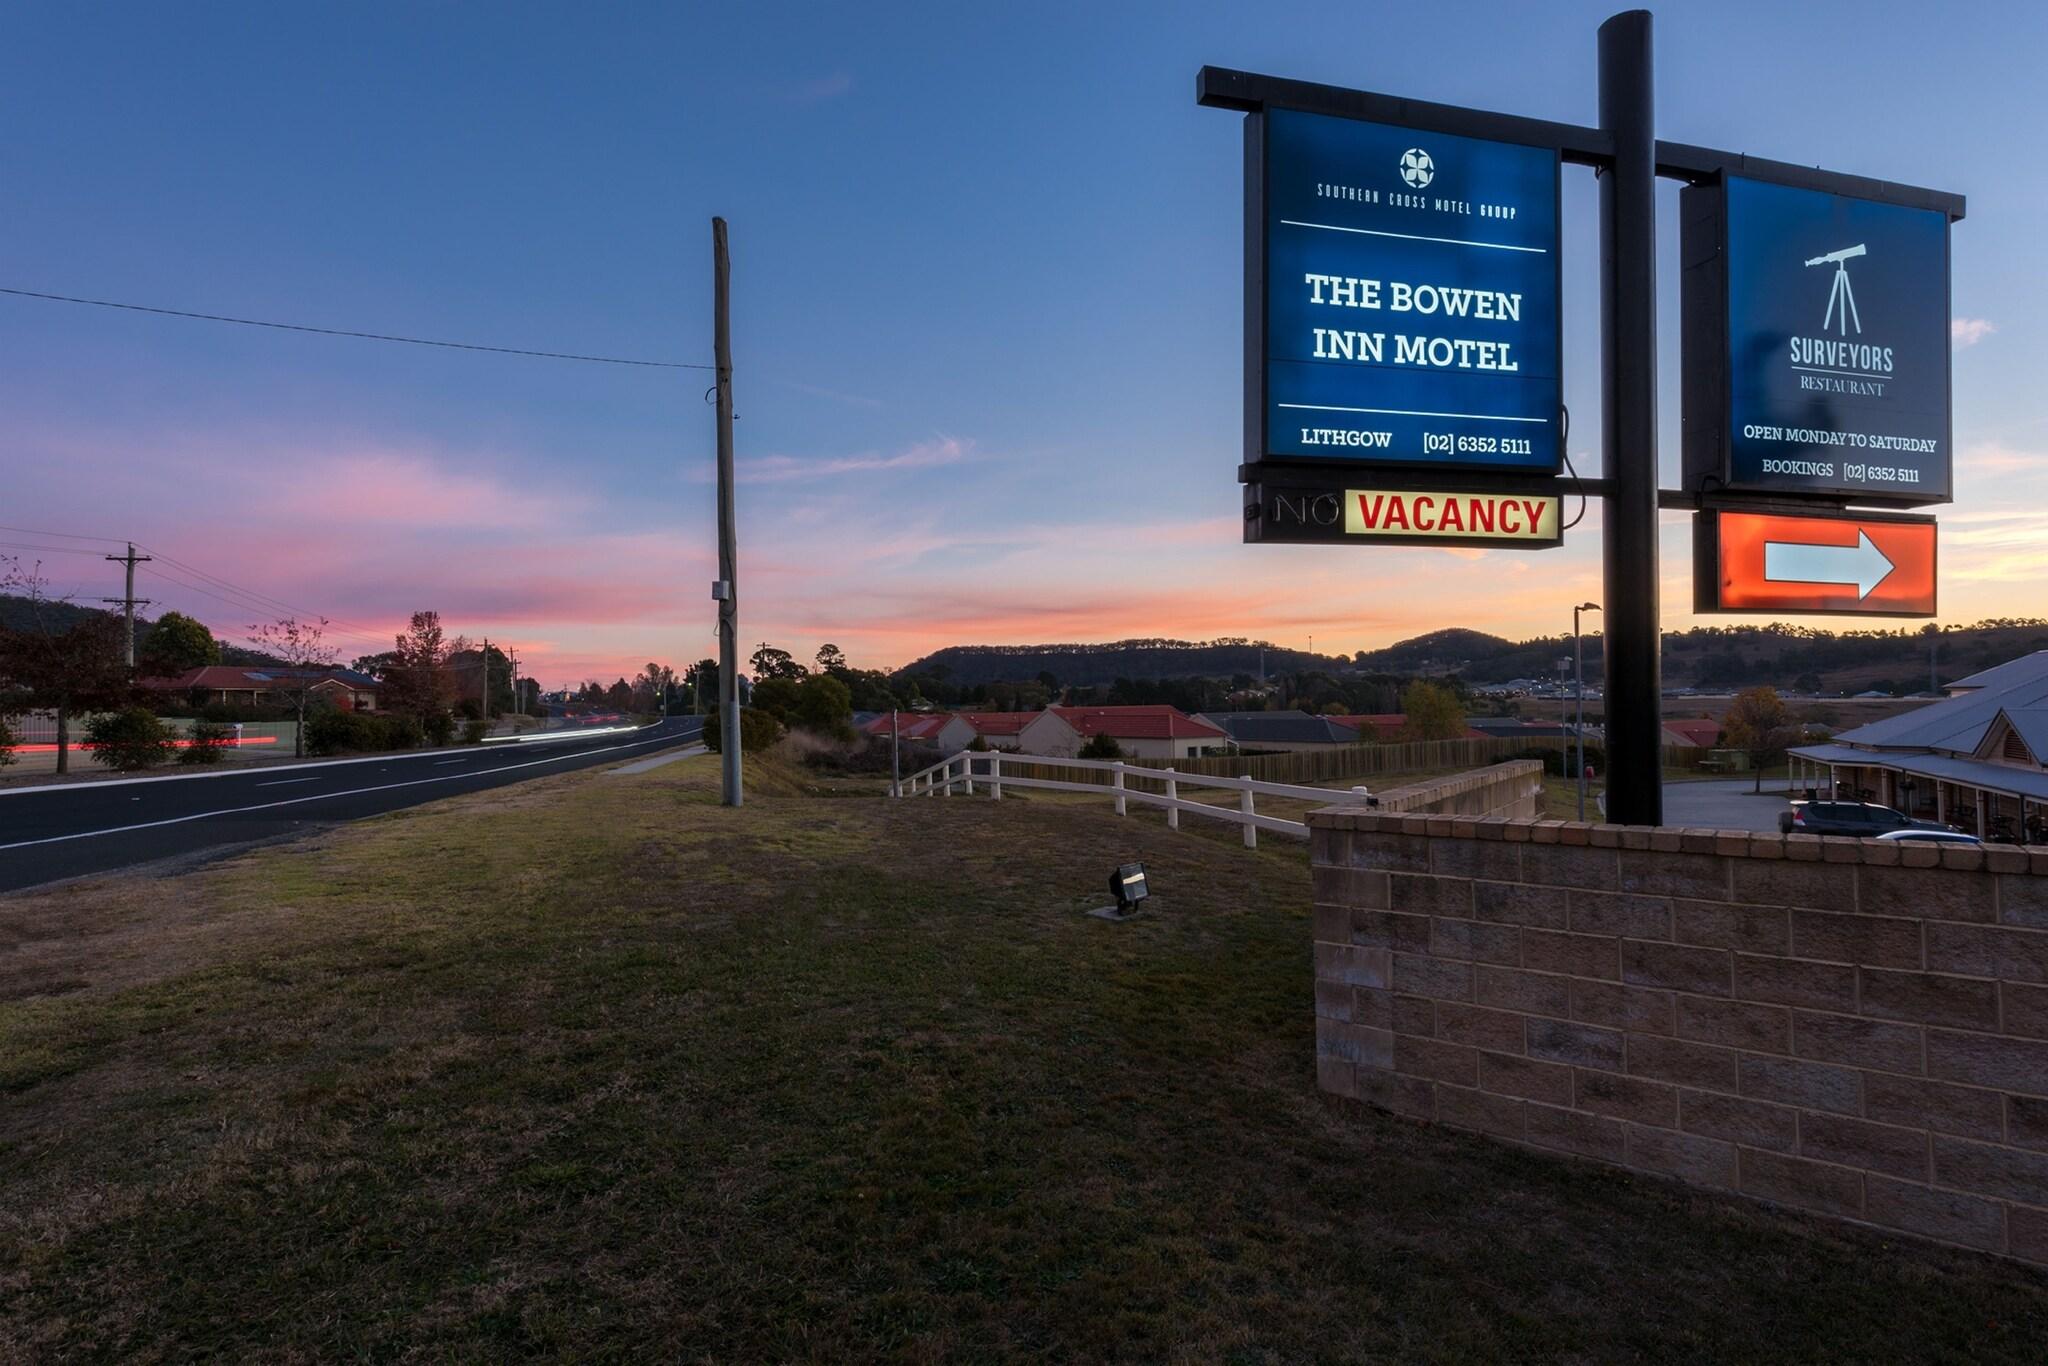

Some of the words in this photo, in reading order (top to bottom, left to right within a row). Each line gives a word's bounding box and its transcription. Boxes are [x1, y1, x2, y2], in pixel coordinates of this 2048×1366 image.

[1317, 183, 1379, 204] SOUTHERN
[1389, 192, 1426, 209] CROSS
[1435, 198, 1471, 215] MOTEL
[1480, 204, 1517, 220] GROUP
[1305, 273, 1381, 310] THE
[1390, 281, 1522, 321] BOWEN
[1313, 328, 1386, 362] INN
[1394, 334, 1518, 371] MOTEL
[1790, 336, 1893, 372] SURVEYORS
[1800, 375, 1885, 397] RESTAURANT
[1301, 428, 1393, 448] LITHGOW
[1423, 432, 1455, 455] [02]
[1458, 435, 1497, 453] 6352
[1501, 438, 1532, 455] 5111
[1743, 424, 1783, 441] OPEN
[1785, 428, 1847, 446] MONDAY
[1849, 433, 1867, 448] TO
[1869, 435, 1937, 453] SATURDAY
[1762, 459, 1834, 477] BOOKINGS
[1843, 462, 1866, 482] [02]
[1868, 467, 1896, 481] 6352
[1898, 468, 1920, 483] 5111
[1272, 493, 1340, 525] NO
[1358, 494, 1547, 534] VACANCY
